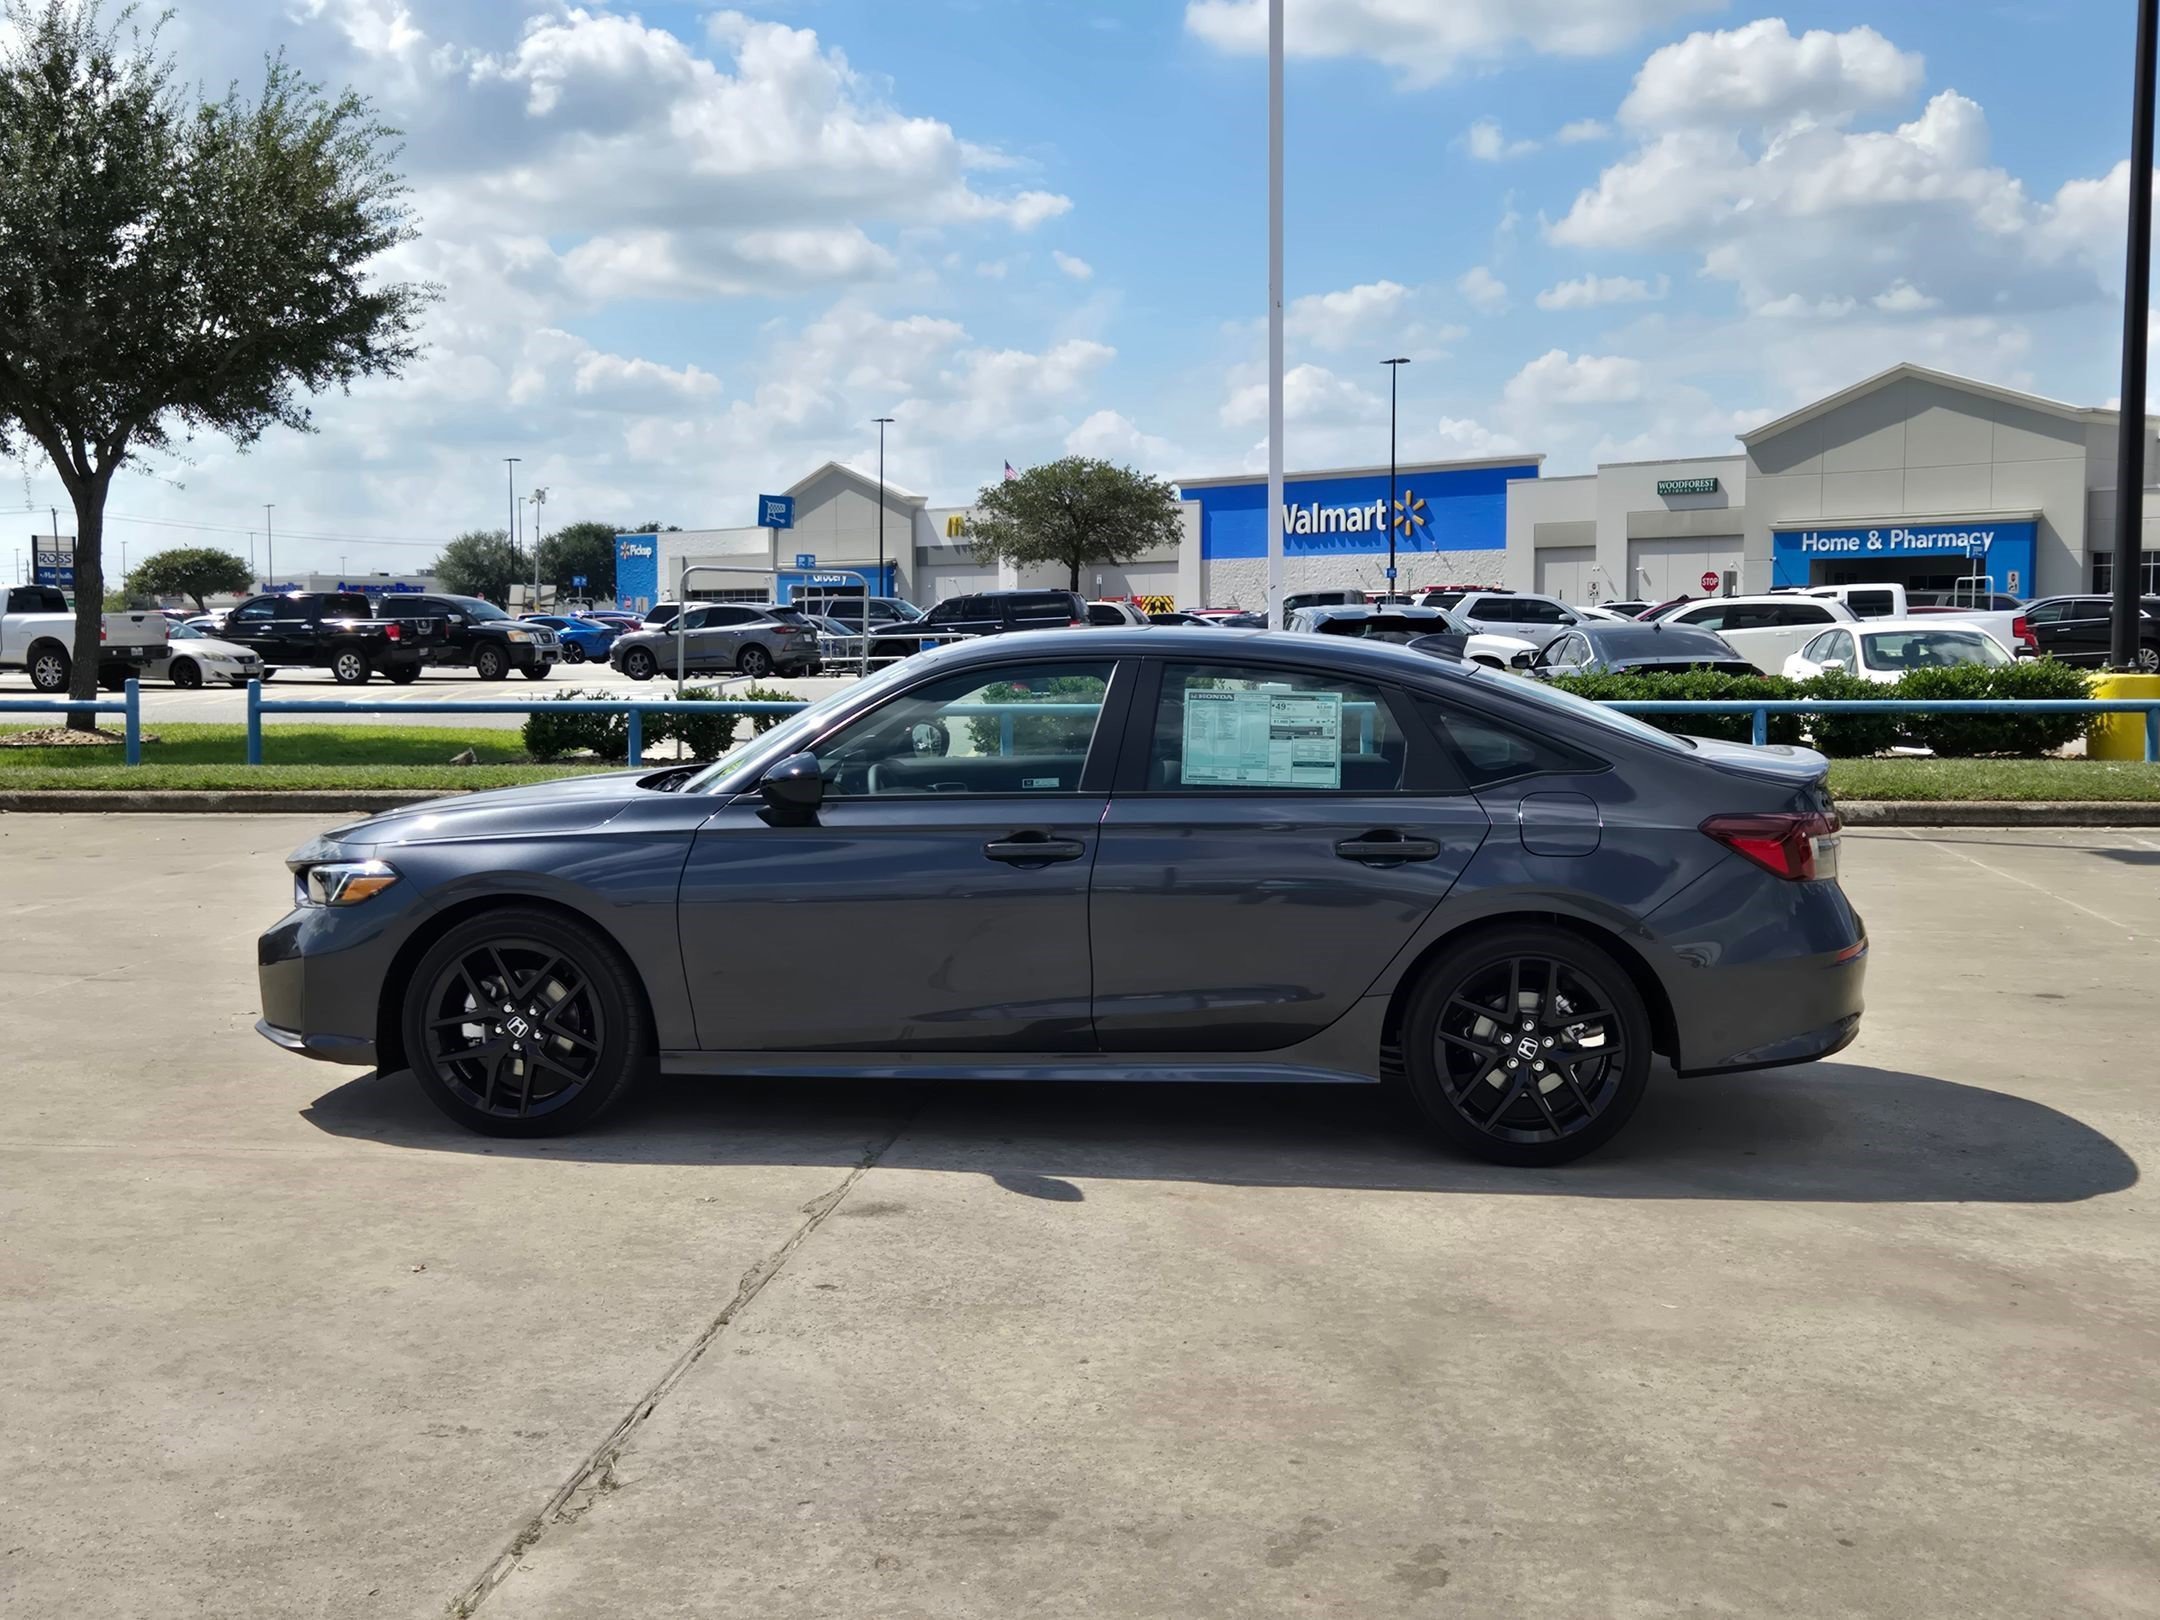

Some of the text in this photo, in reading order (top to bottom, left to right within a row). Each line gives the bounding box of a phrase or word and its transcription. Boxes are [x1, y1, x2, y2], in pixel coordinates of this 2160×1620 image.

[1658, 480, 1714, 489] WOODFOREST
[1801, 529, 1995, 552] Home & Pharmacy
[629, 544, 653, 559] Pickup
[39, 553, 73, 564] ROSS
[1702, 577, 1719, 586] STOP
